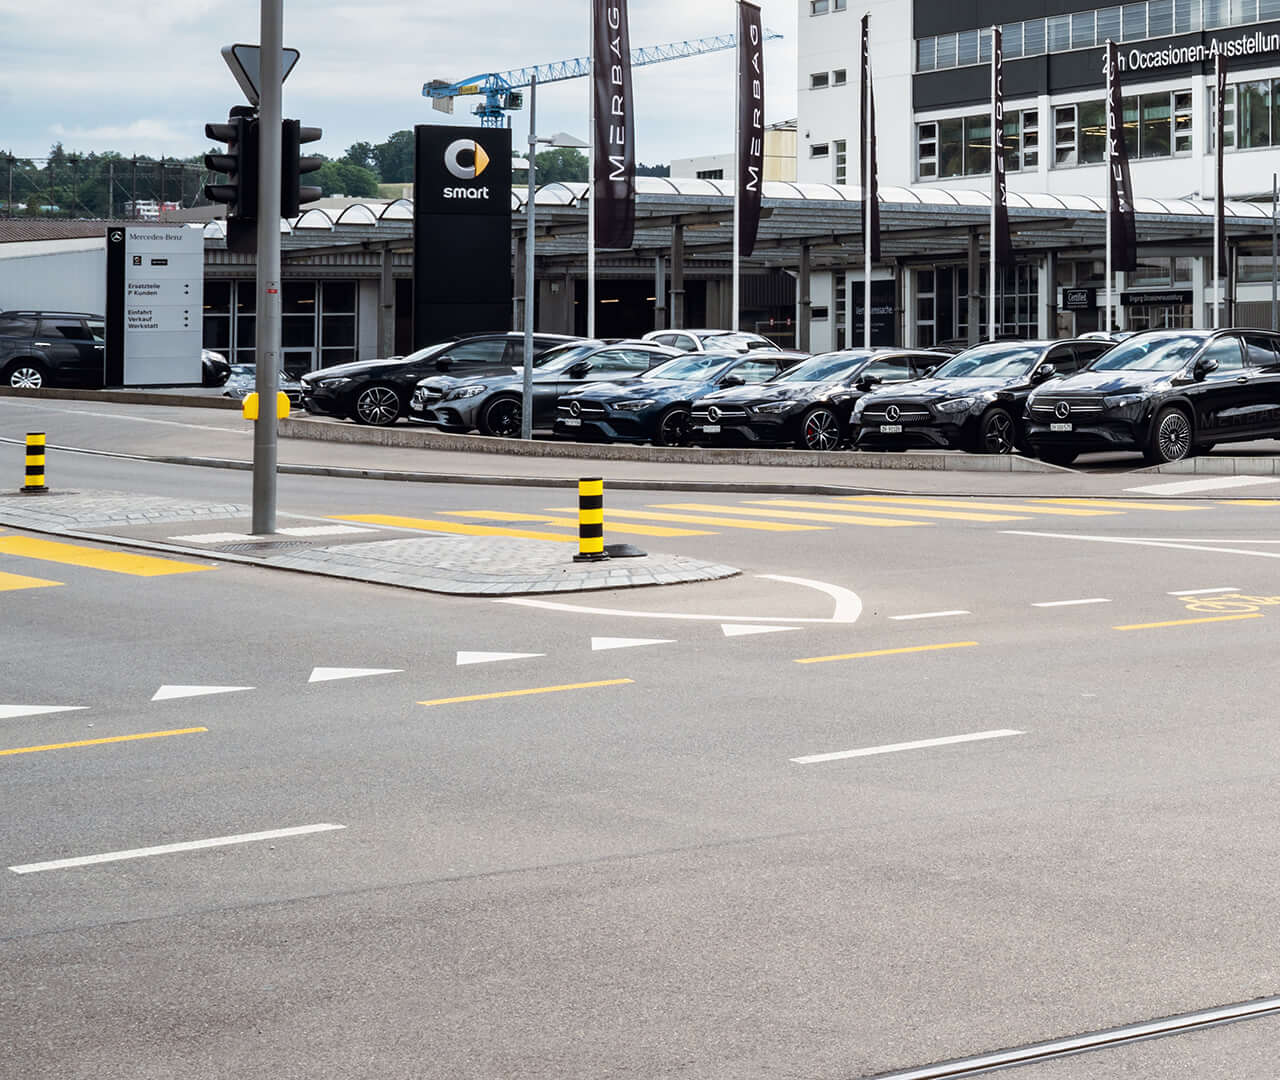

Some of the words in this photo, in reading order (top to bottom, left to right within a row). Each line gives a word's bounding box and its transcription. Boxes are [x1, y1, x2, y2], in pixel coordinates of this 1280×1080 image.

[608, 7, 625, 181] MERBAG
[746, 24, 761, 191] MERBAG
[1102, 53, 1125, 74] 2h
[443, 186, 489, 199] smart
